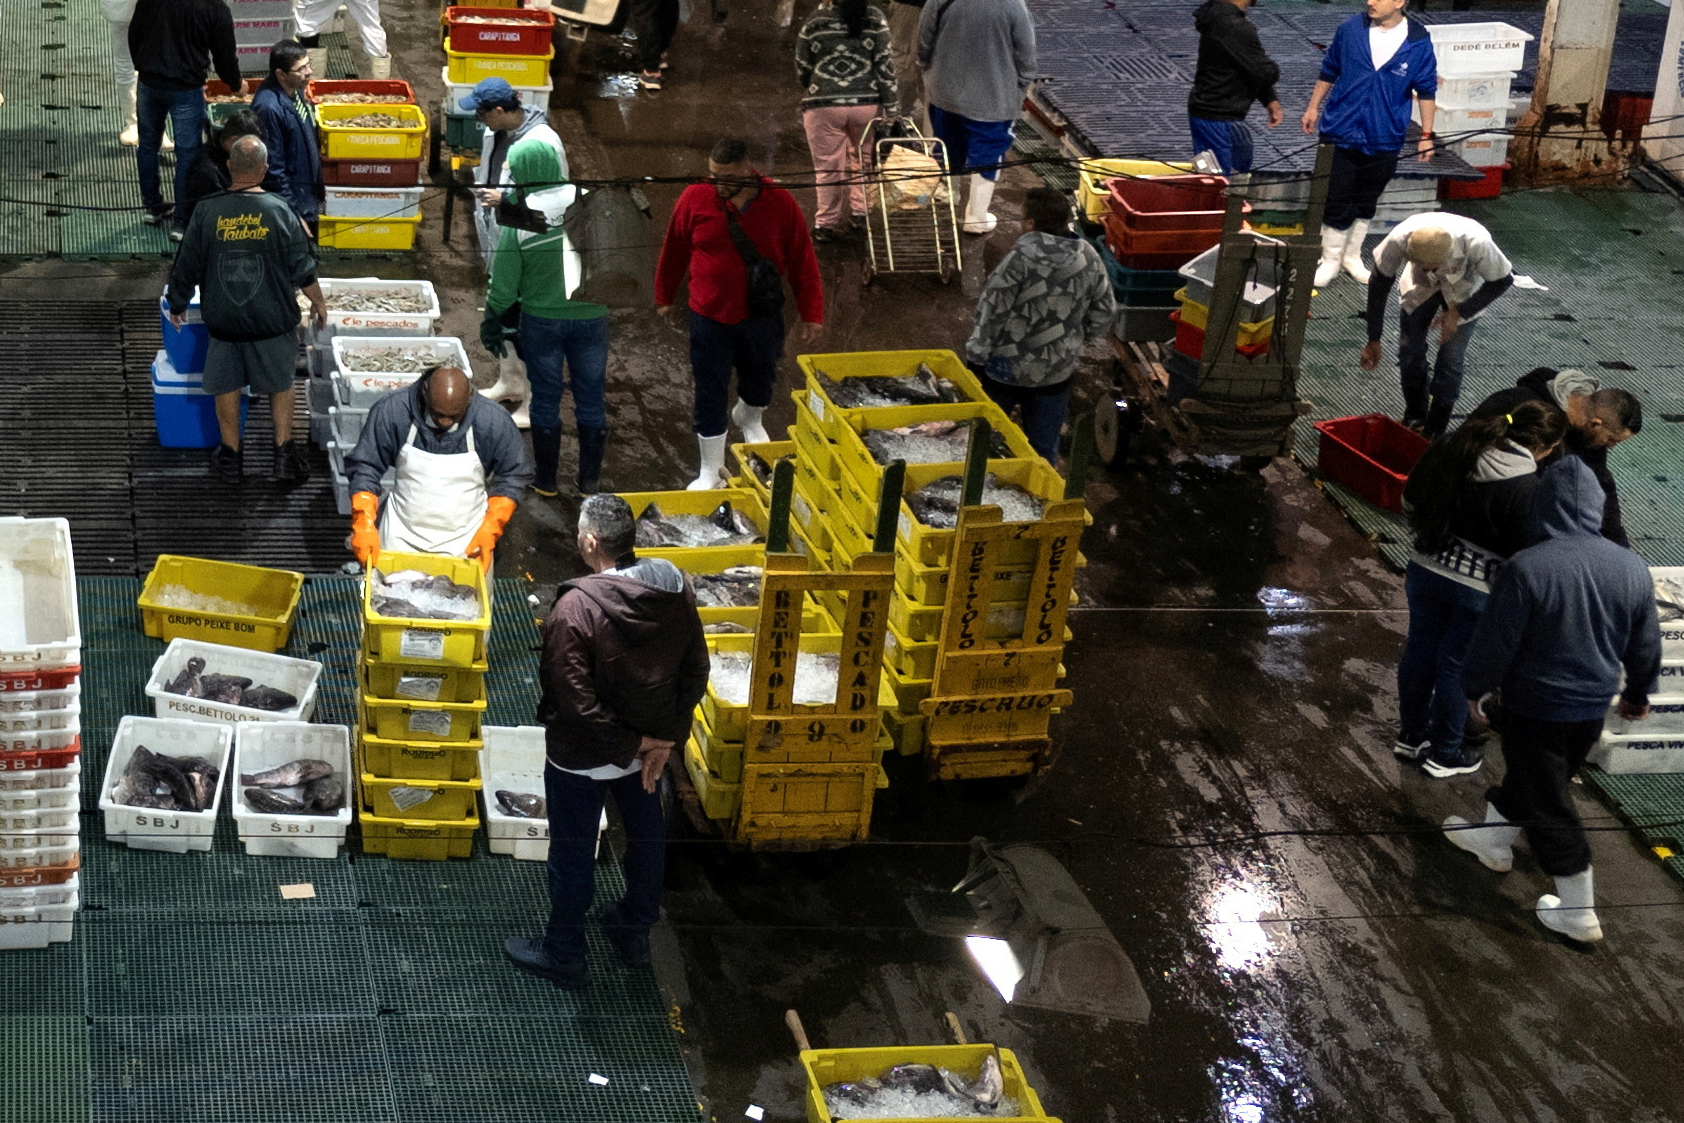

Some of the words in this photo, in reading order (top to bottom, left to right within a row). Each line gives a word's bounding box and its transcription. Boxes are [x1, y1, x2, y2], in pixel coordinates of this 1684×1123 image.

[478, 31, 521, 42] CARAPITANGA
[1453, 42, 1481, 51] DEDÉ
[1484, 40, 1520, 50] BELÉM
[365, 318, 419, 329] pescados
[168, 614, 202, 627] GRUPO
[203, 619, 232, 631] PEIXE
[234, 621, 255, 633] BOM
[807, 720, 825, 742] 9
[1627, 740, 1665, 750] PESCA
